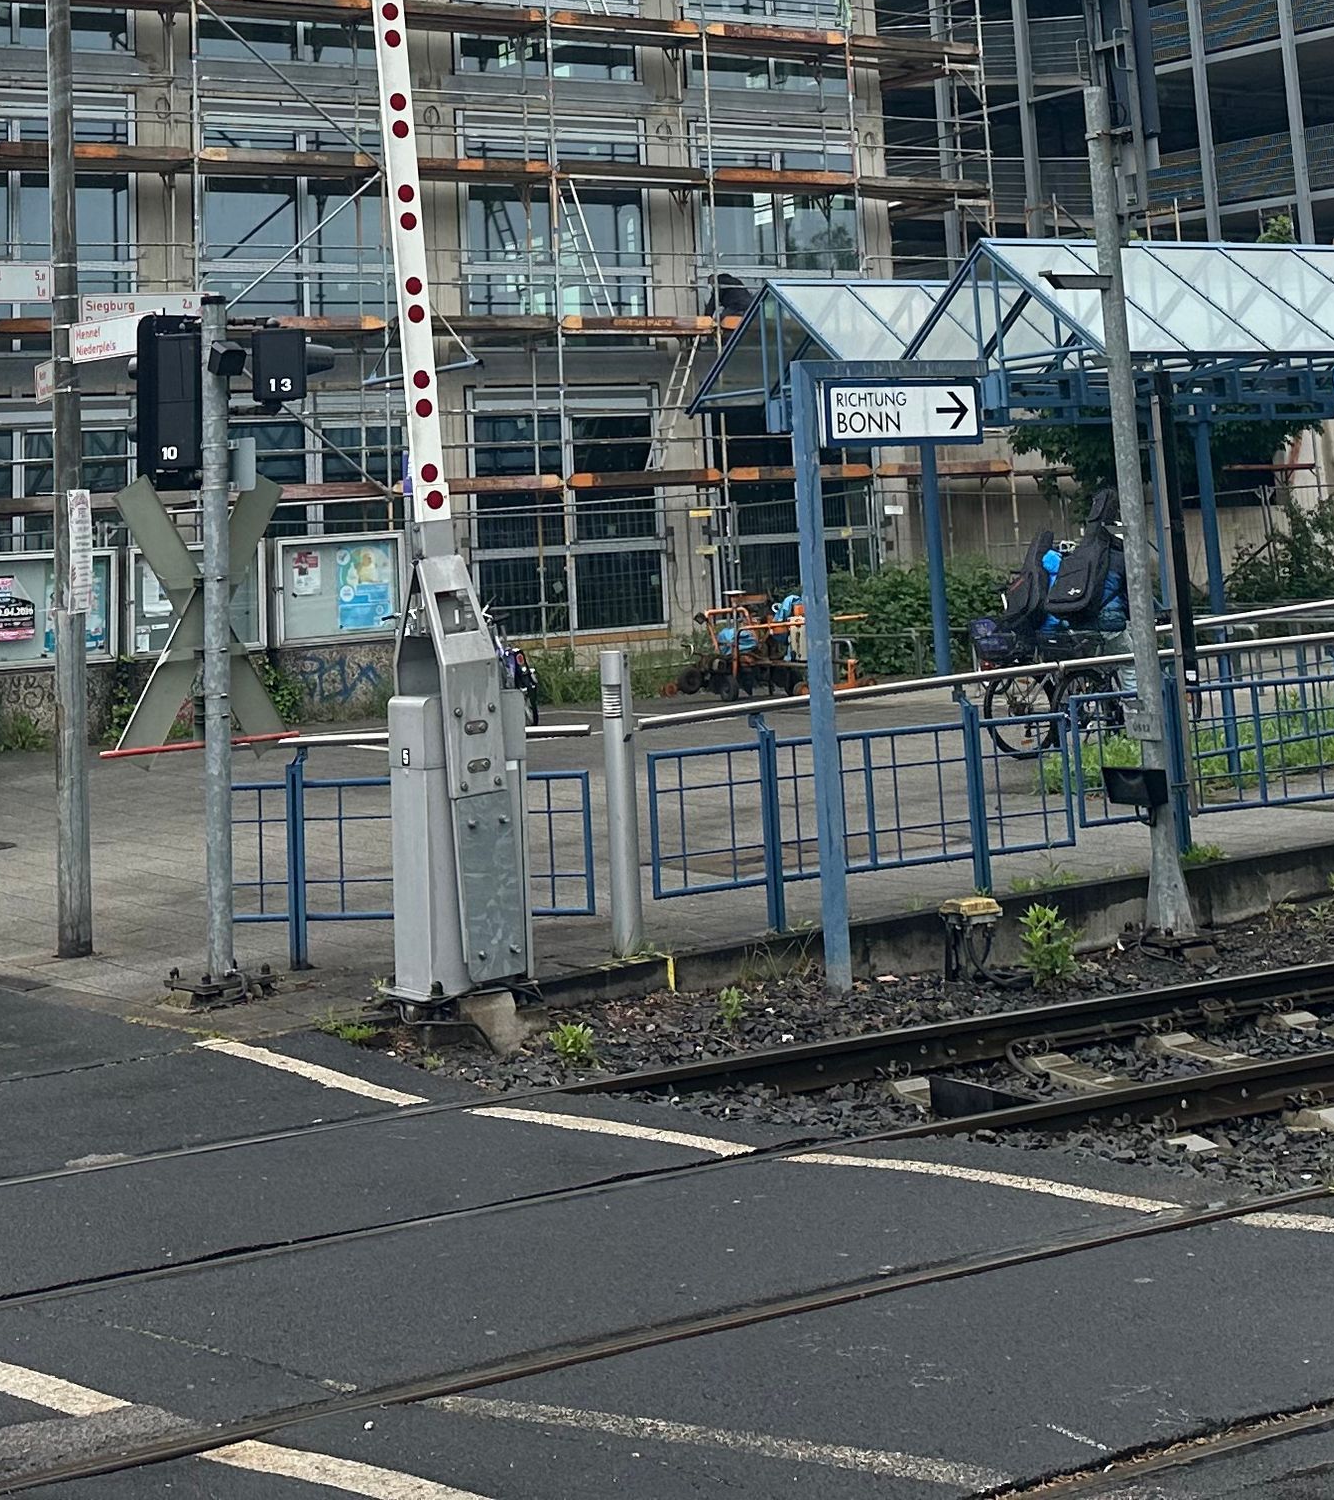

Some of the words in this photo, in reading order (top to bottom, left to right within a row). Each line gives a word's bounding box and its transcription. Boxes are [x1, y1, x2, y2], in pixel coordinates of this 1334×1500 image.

[86, 300, 135, 313] Siegburg
[269, 378, 292, 392] 13
[836, 391, 907, 407] RICHTUNG
[837, 411, 901, 433] BONN
[161, 446, 178, 460] 10
